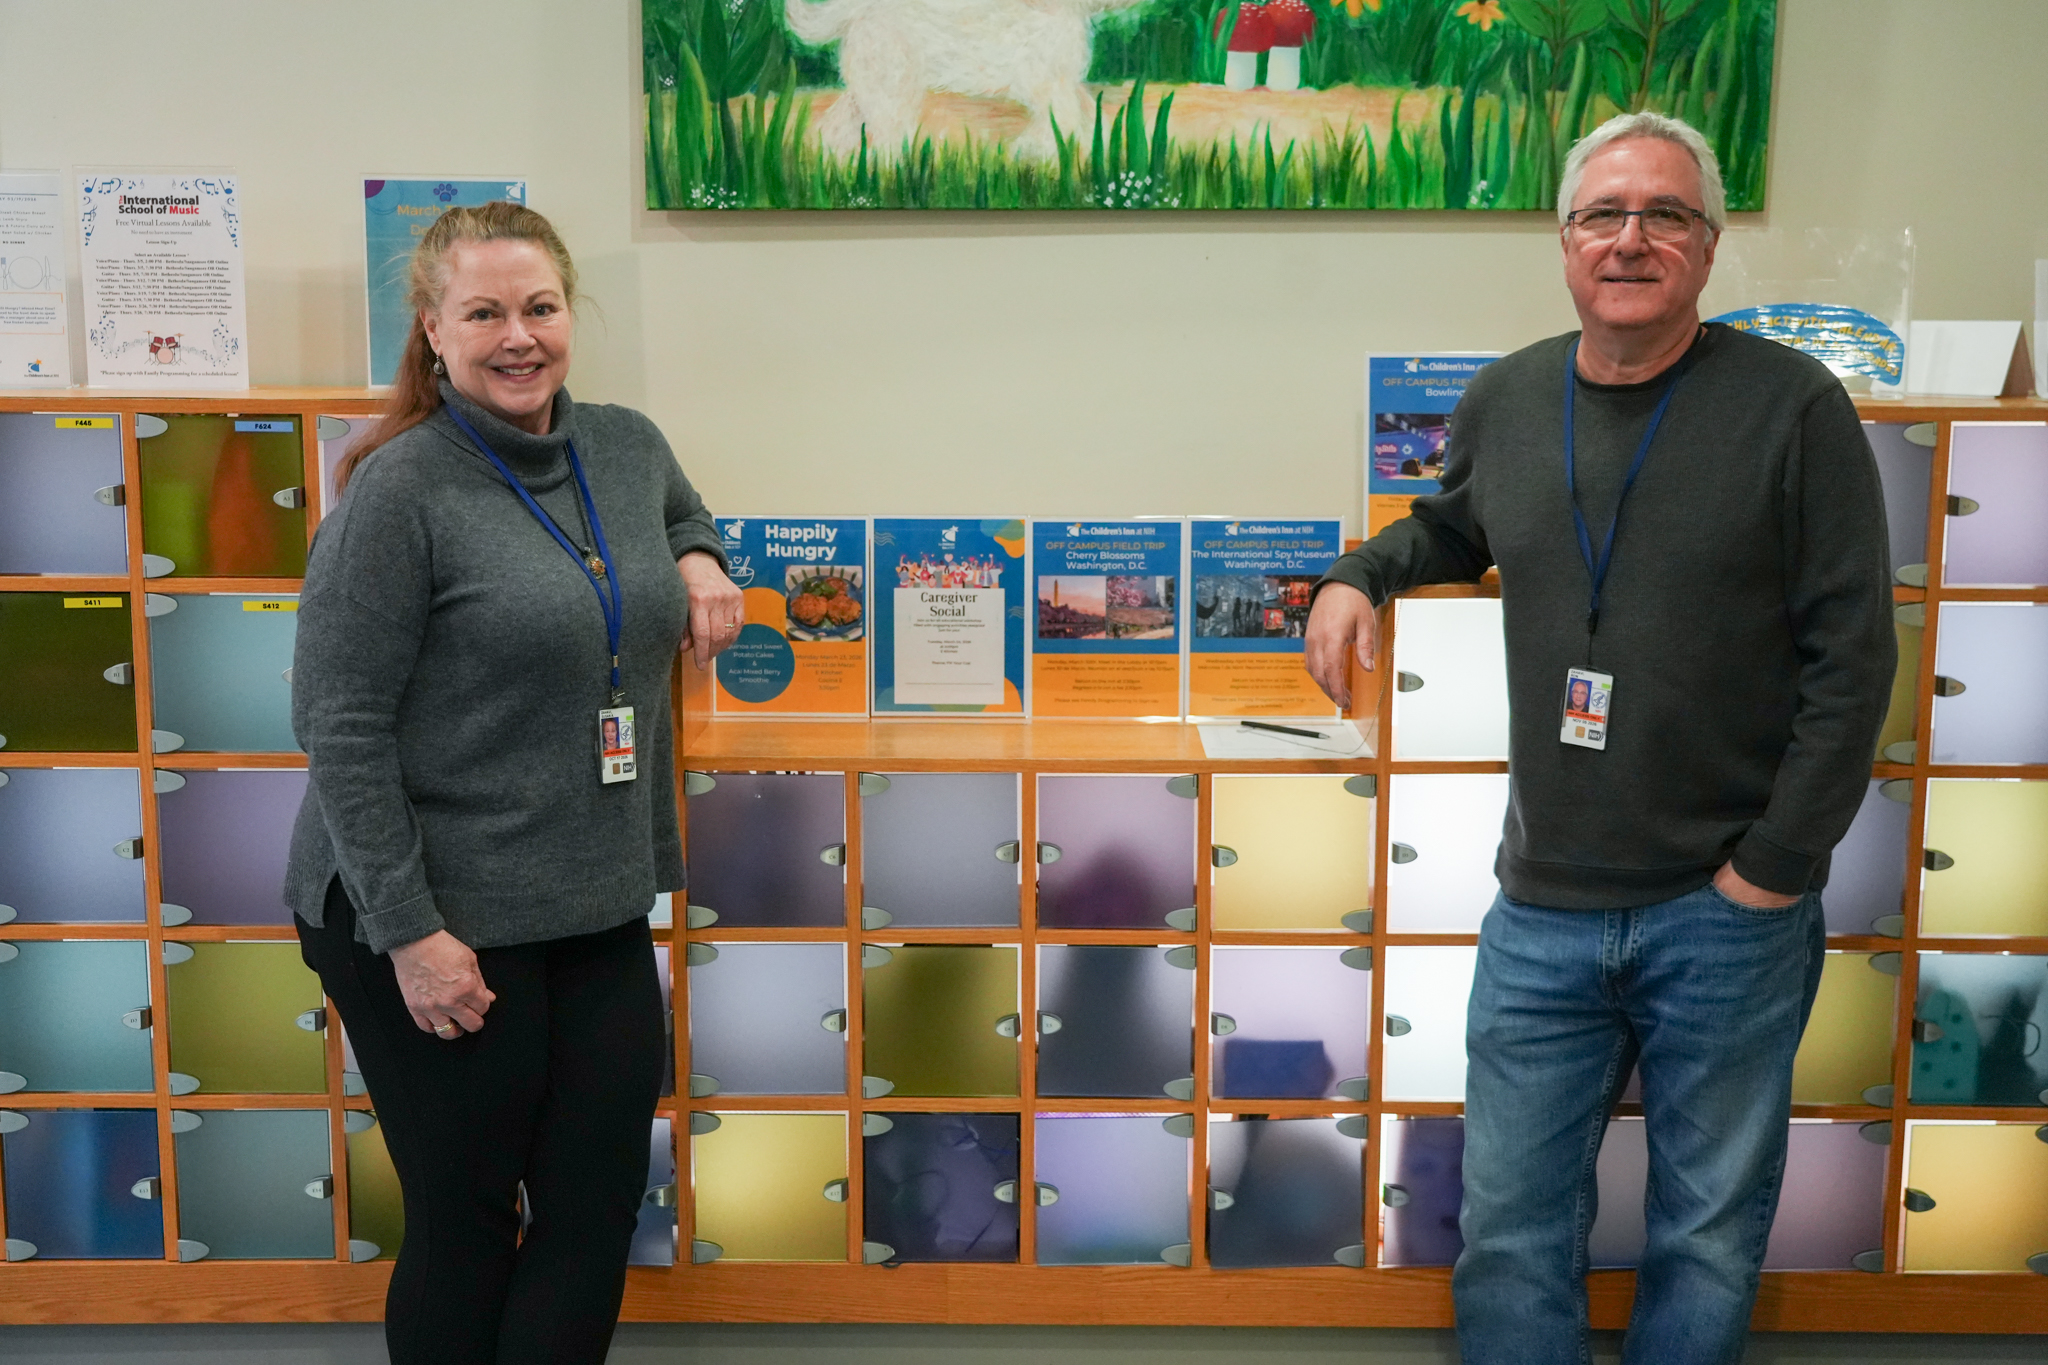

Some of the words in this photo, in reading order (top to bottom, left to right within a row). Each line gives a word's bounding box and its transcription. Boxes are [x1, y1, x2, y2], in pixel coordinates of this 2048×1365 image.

[124, 195, 200, 205] International
[119, 205, 154, 214] School
[157, 205, 167, 214] of
[170, 206, 200, 215] Music
[398, 205, 441, 216] March
[156, 219, 181, 227] Lessons
[182, 219, 212, 227] Available
[1429, 363, 1461, 372] Children's
[1463, 363, 1475, 371] Inn
[1383, 378, 1402, 386] OFF
[1405, 378, 1449, 386] CAMPUS
[765, 523, 838, 542] Happily
[1081, 527, 1090, 535] The
[1090, 526, 1122, 536] Children's
[1124, 527, 1135, 535] Inn
[1249, 525, 1280, 534] Children's
[1282, 526, 1293, 534] Inn
[1046, 542, 1065, 550] OFF
[1068, 542, 1111, 550] CAMPUS
[1113, 542, 1142, 550] FIELD
[1144, 542, 1166, 550] TRIP
[1204, 541, 1224, 549] OFF
[1226, 541, 1268, 549] CAMPUS
[1271, 541, 1300, 549] FIELD
[1302, 541, 1324, 549] TRIP
[766, 543, 837, 561] Hungry
[1066, 551, 1097, 561] Cherry
[1101, 551, 1145, 560] Blossoms
[1192, 551, 1208, 559] The
[1211, 550, 1272, 559] International
[1274, 551, 1291, 560] Spy
[1294, 551, 1336, 559] Museum
[1066, 562, 1126, 570] Washington,
[1129, 562, 1147, 570] D.C.
[1224, 561, 1284, 570] Washington,
[1287, 561, 1305, 570] D.C.
[921, 592, 978, 605] Caregiver
[930, 605, 966, 617] Social
